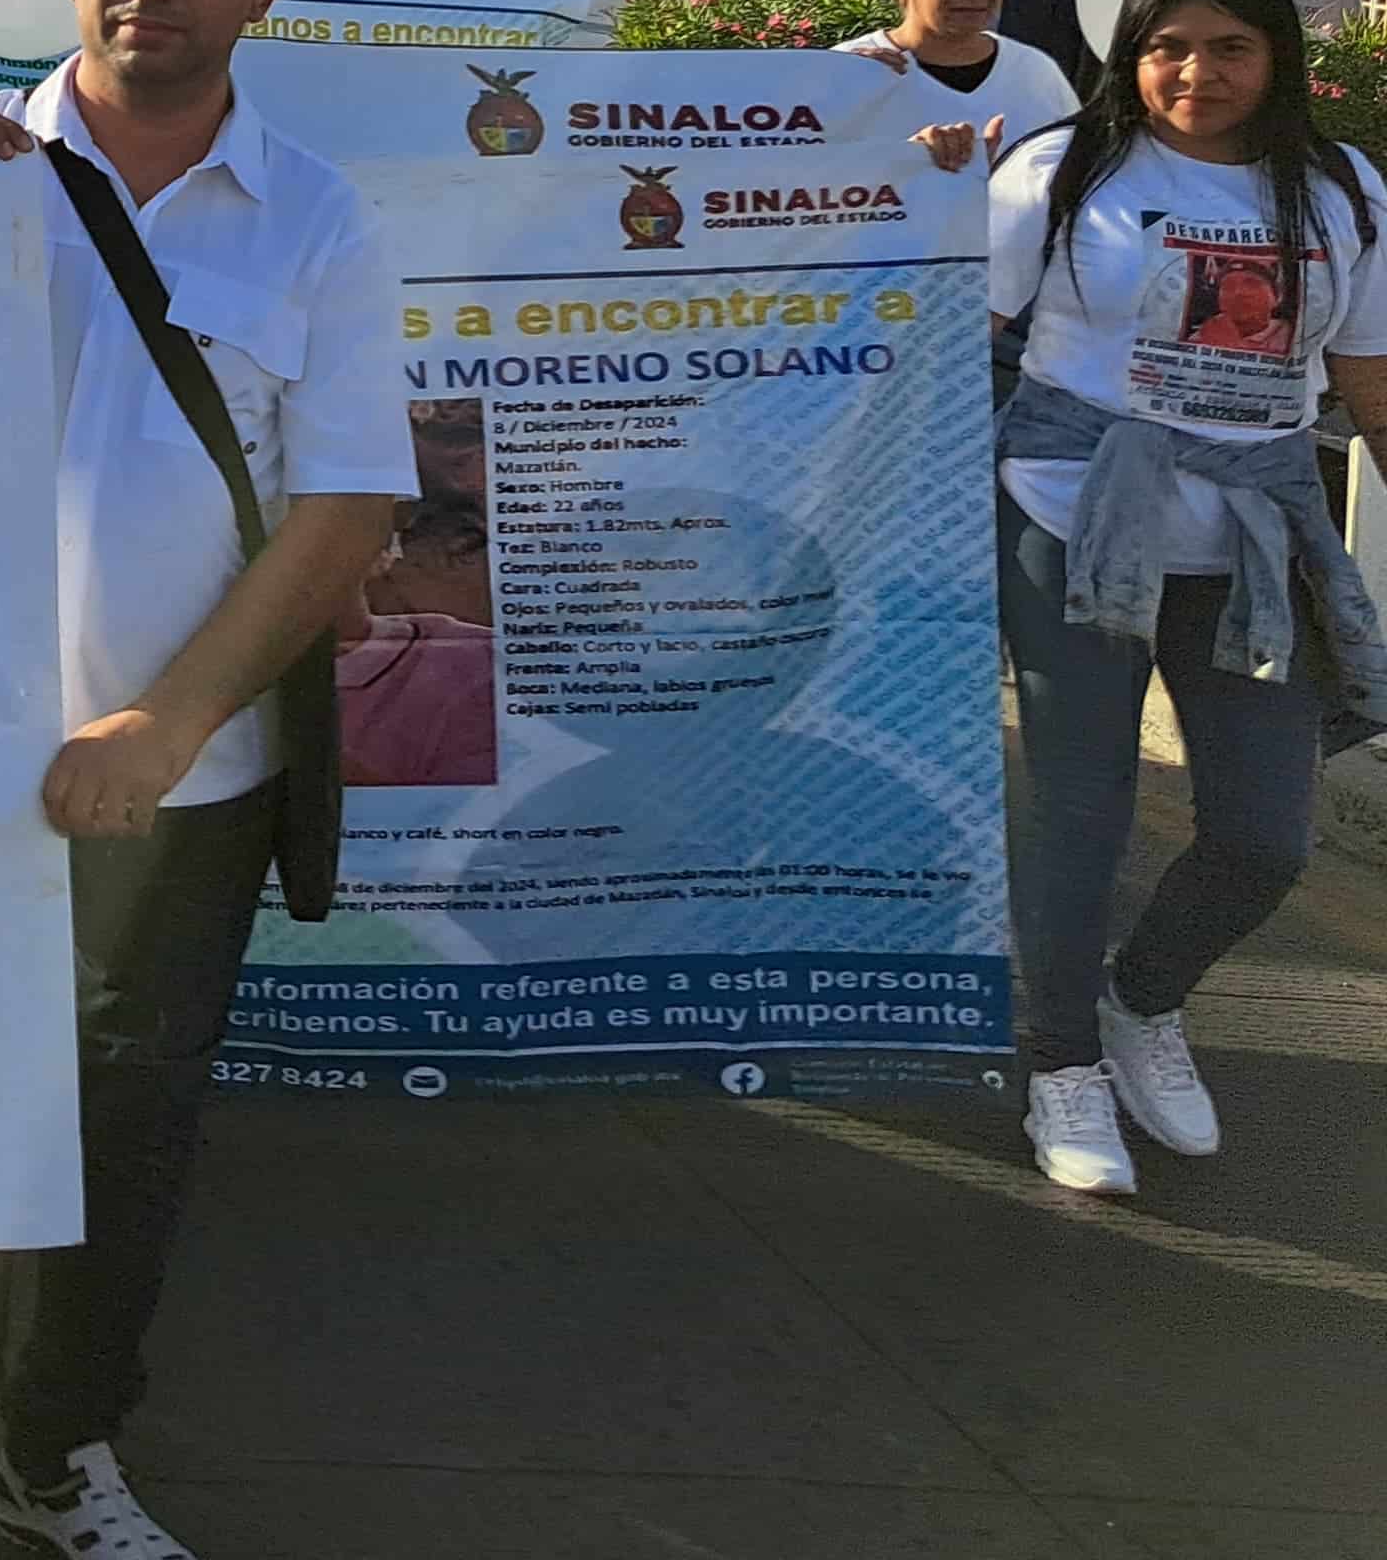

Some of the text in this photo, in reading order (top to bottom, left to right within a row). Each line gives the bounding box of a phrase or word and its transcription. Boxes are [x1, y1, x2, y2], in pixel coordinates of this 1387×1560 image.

[242, 15, 538, 46] anos a encontrar
[567, 103, 825, 132] SINALOA
[567, 134, 683, 149] GOBIERNO
[690, 134, 732, 148] DEL
[703, 184, 905, 215] SINALOA
[703, 209, 908, 230] GOBIERNO DEL ESTADO
[402, 288, 916, 339] s a encontrar a
[445, 351, 669, 390] MORENO
[686, 343, 895, 383] SOLANO
[493, 395, 705, 414] Fecha de Desaparición:
[494, 422, 505, 434] 8
[524, 418, 615, 434] Diciembre
[632, 416, 678, 429] 2024
[495, 439, 586, 457] Municipio
[549, 479, 624, 492] Hombre
[497, 499, 624, 513] Edad: 22 años
[541, 540, 603, 553] Blanco
[622, 558, 699, 571] Robusto
[650, 602, 659, 614] y
[583, 641, 635, 653] Corto
[641, 643, 650, 655] y
[453, 826, 496, 840] short
[480, 969, 649, 1001] referente
[667, 972, 690, 991] a
[709, 968, 789, 991] esta
[809, 968, 992, 995] persona,
[425, 1009, 468, 1033] Tu
[482, 1005, 595, 1040] ayuda
[607, 1006, 652, 1027] es
[663, 1005, 748, 1032] muy
[758, 1000, 994, 1028] importante.
[210, 1060, 368, 1090] 327 8424
